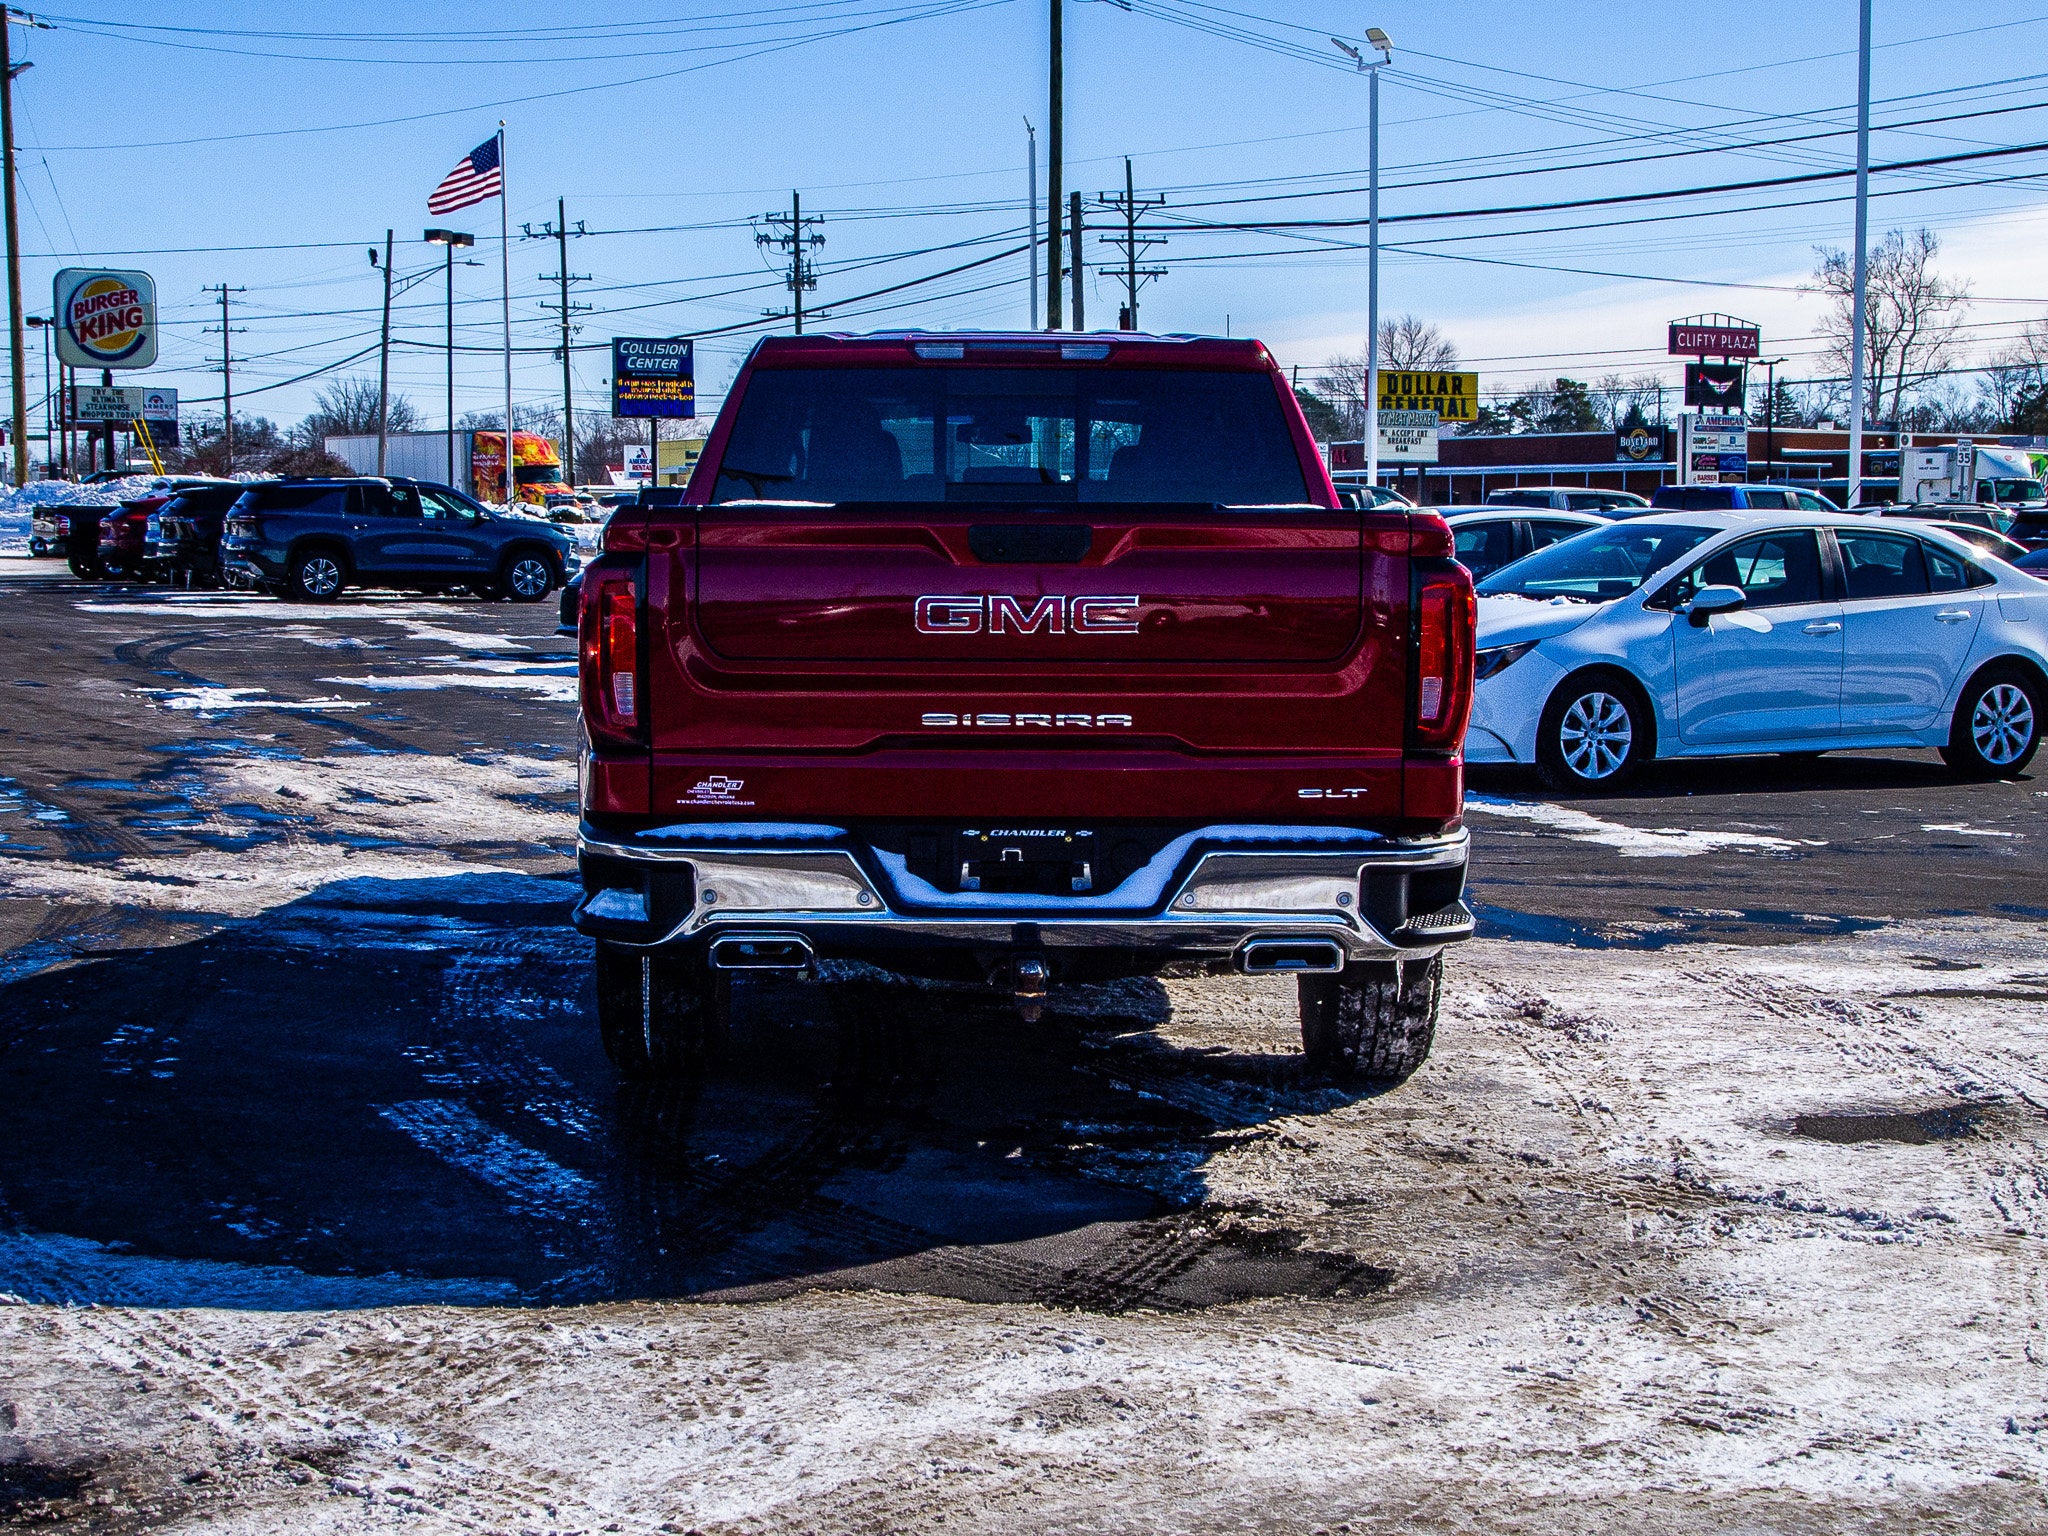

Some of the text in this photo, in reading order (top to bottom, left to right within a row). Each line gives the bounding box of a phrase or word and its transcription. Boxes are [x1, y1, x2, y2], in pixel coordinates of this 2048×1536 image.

[73, 289, 139, 320] BURGER
[79, 307, 143, 343] KING
[1677, 332, 1757, 350] CLIFTY PLAZA
[620, 341, 688, 355] COLLISION
[627, 356, 679, 369] CENTER
[1387, 373, 1464, 395] DOLLAR
[92, 388, 125, 396] TRY THE
[86, 403, 130, 411] STEAKHOUSE
[1381, 396, 1470, 418] GENERAL
[1705, 416, 1745, 426] AMERICAN
[1392, 429, 1414, 437] ACCEPT
[1387, 437, 1422, 445] BREAKFAST
[1958, 453, 1971, 464] 35
[914, 594, 1140, 634] GMC
[921, 713, 1133, 727] SIERRA
[1297, 788, 1368, 798] SLT
[989, 829, 1067, 837] CHANDLER
